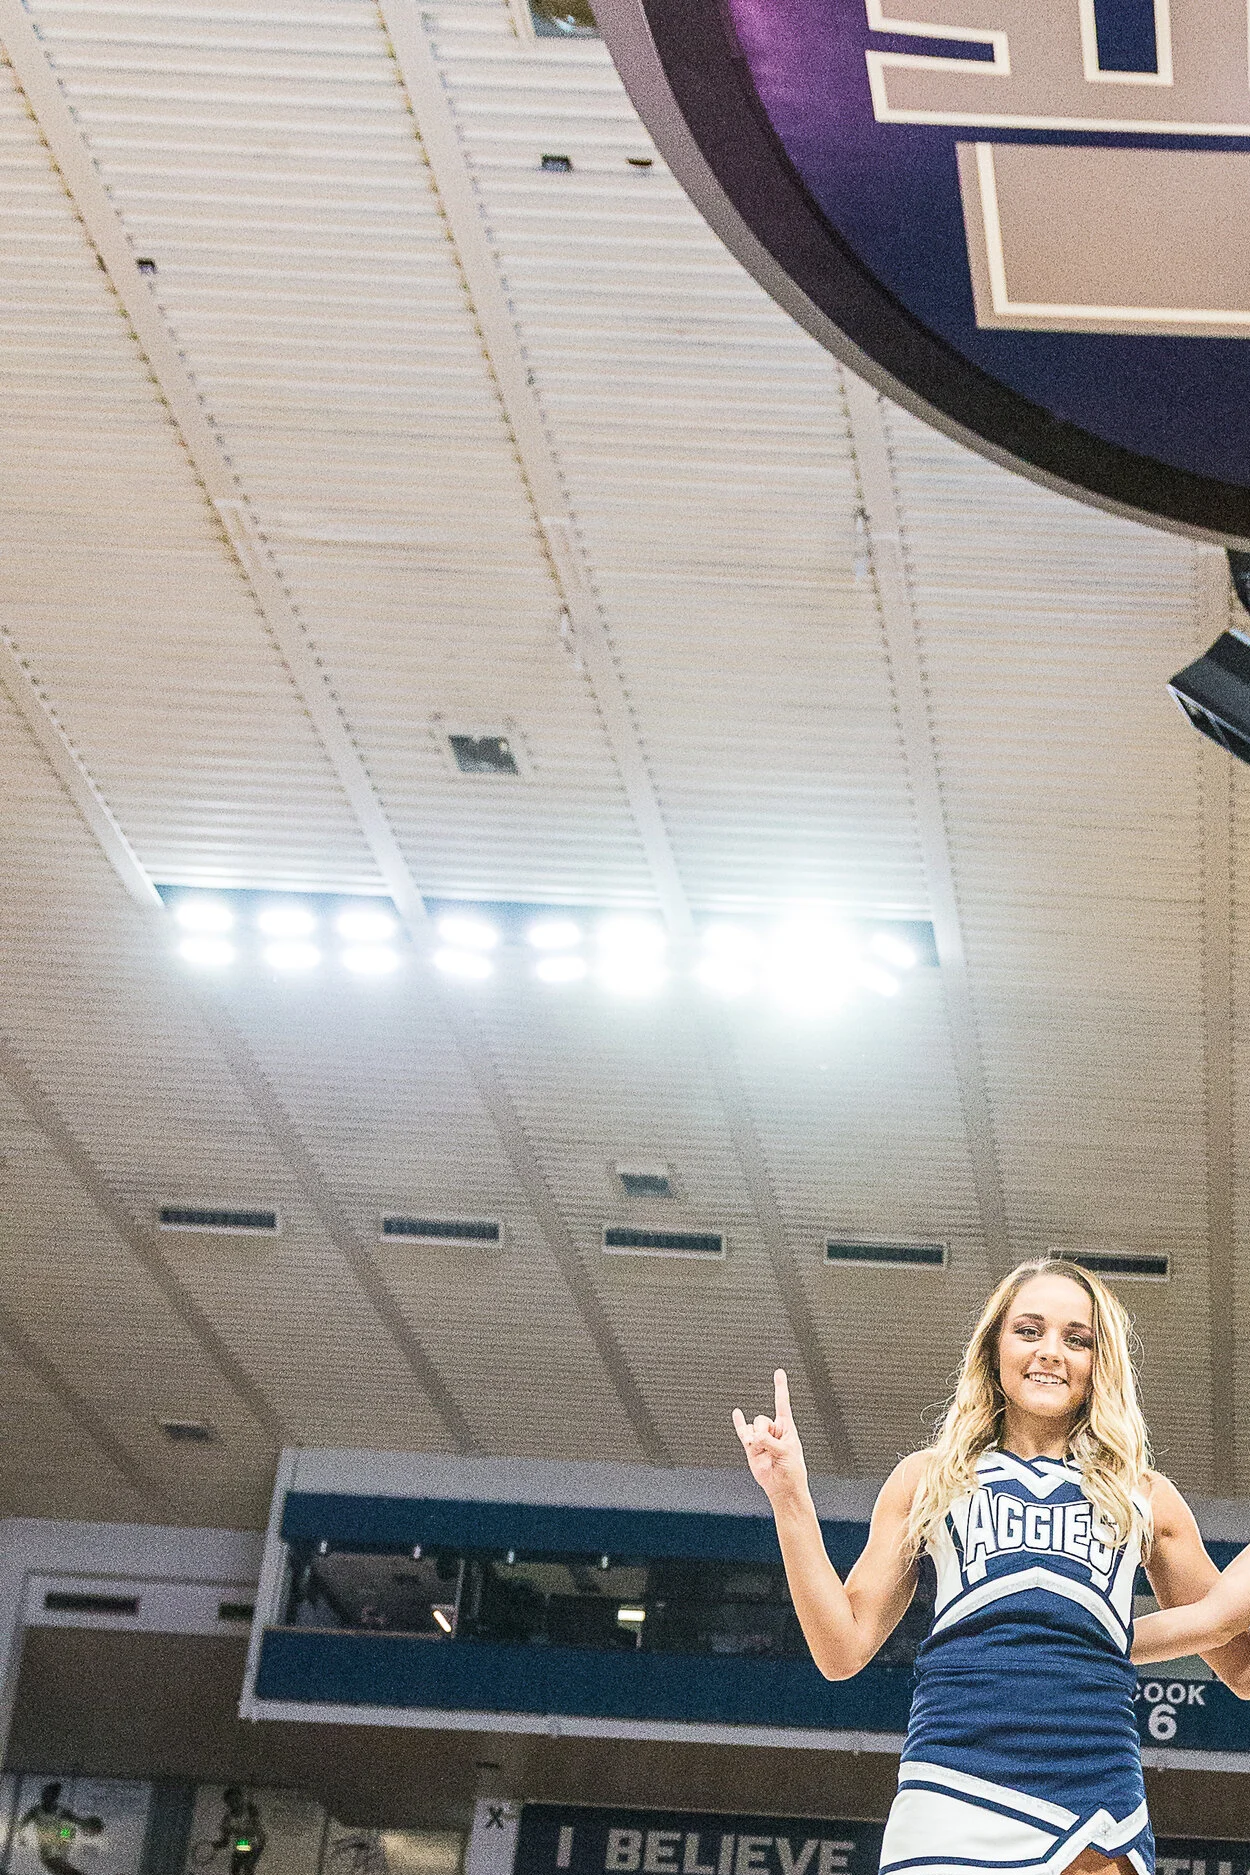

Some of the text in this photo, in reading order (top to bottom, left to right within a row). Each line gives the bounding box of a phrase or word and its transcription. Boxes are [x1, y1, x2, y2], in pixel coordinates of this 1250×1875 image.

[1133, 1681, 1206, 1706] OOK
[1148, 1703, 1177, 1740] 6
[555, 1826, 574, 1869] I
